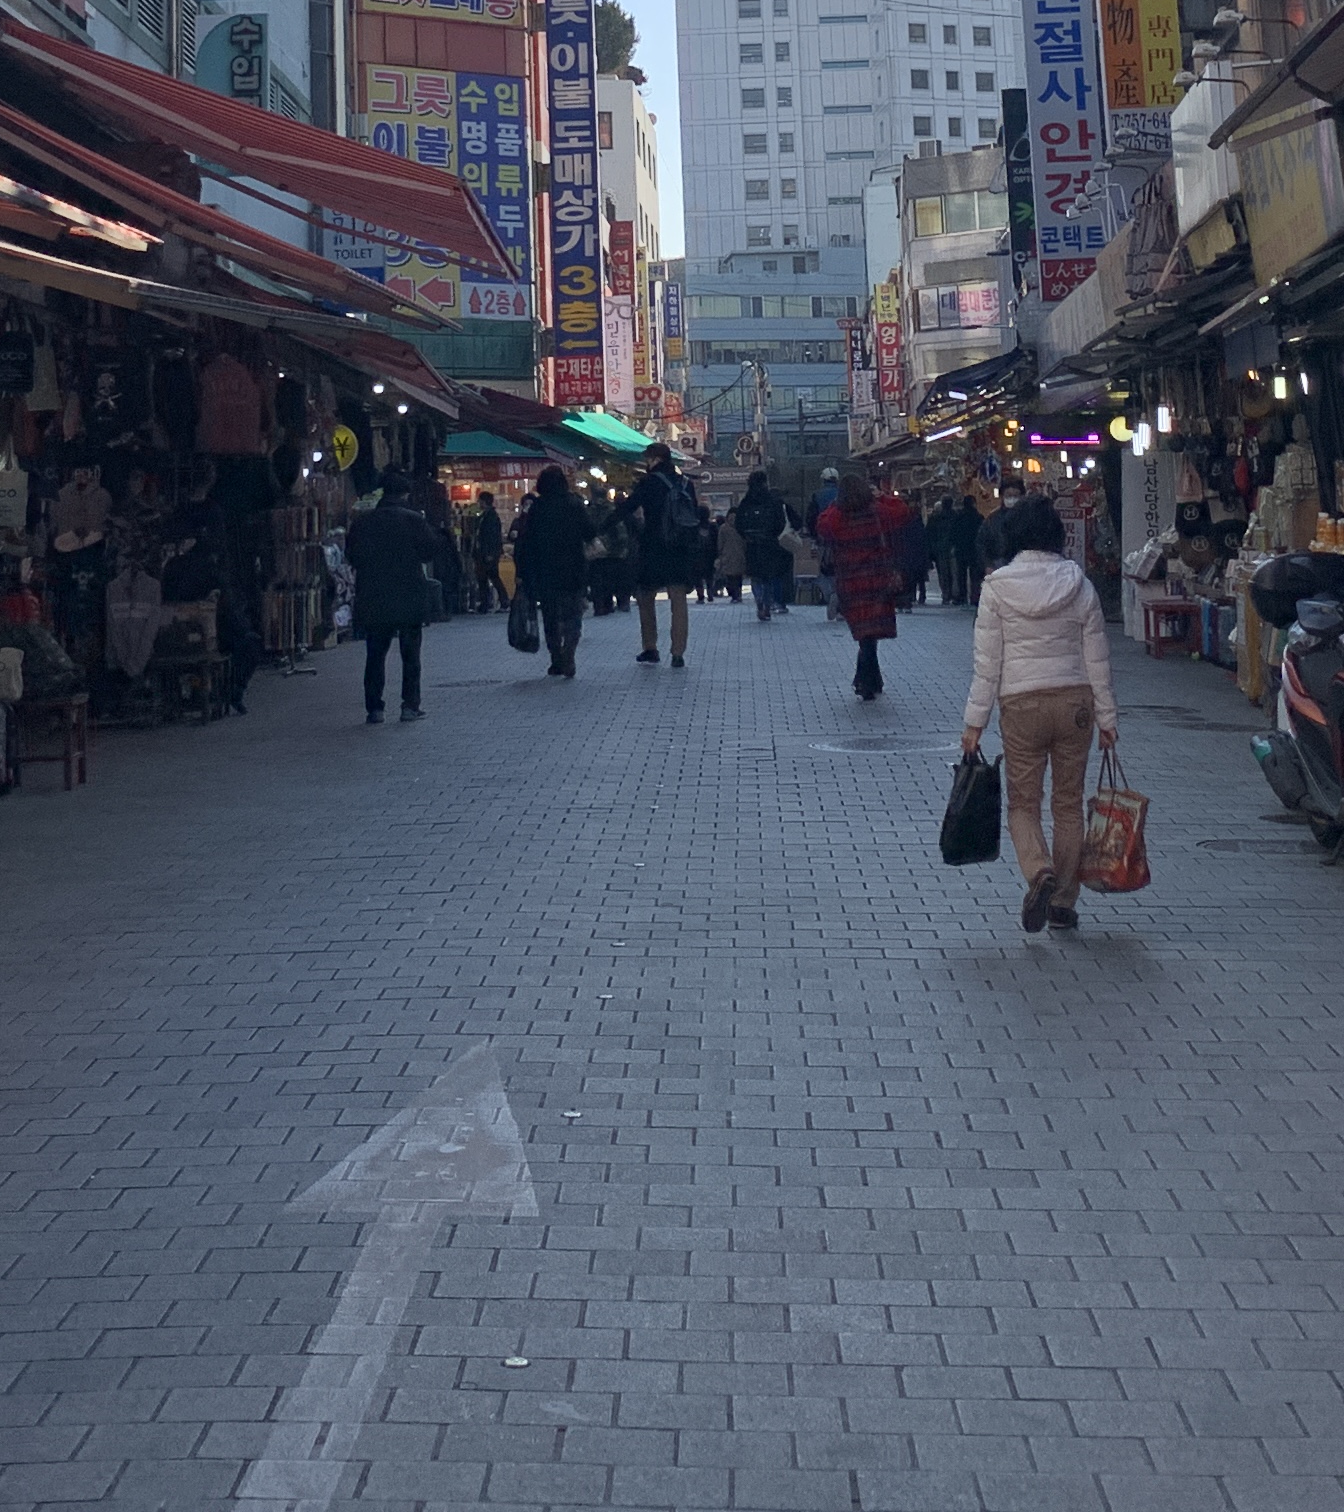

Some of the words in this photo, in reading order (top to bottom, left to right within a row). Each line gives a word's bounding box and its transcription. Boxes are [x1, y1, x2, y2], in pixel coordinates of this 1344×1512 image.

[370, 70, 453, 118] 그릇
[460, 80, 520, 117] 수입
[372, 120, 452, 168] 이불
[462, 121, 522, 158] 명품
[463, 162, 524, 198] 의류
[334, 249, 372, 259] TOILET
[1040, 225, 1105, 253] 콘택트
[558, 266, 600, 333] 3층
